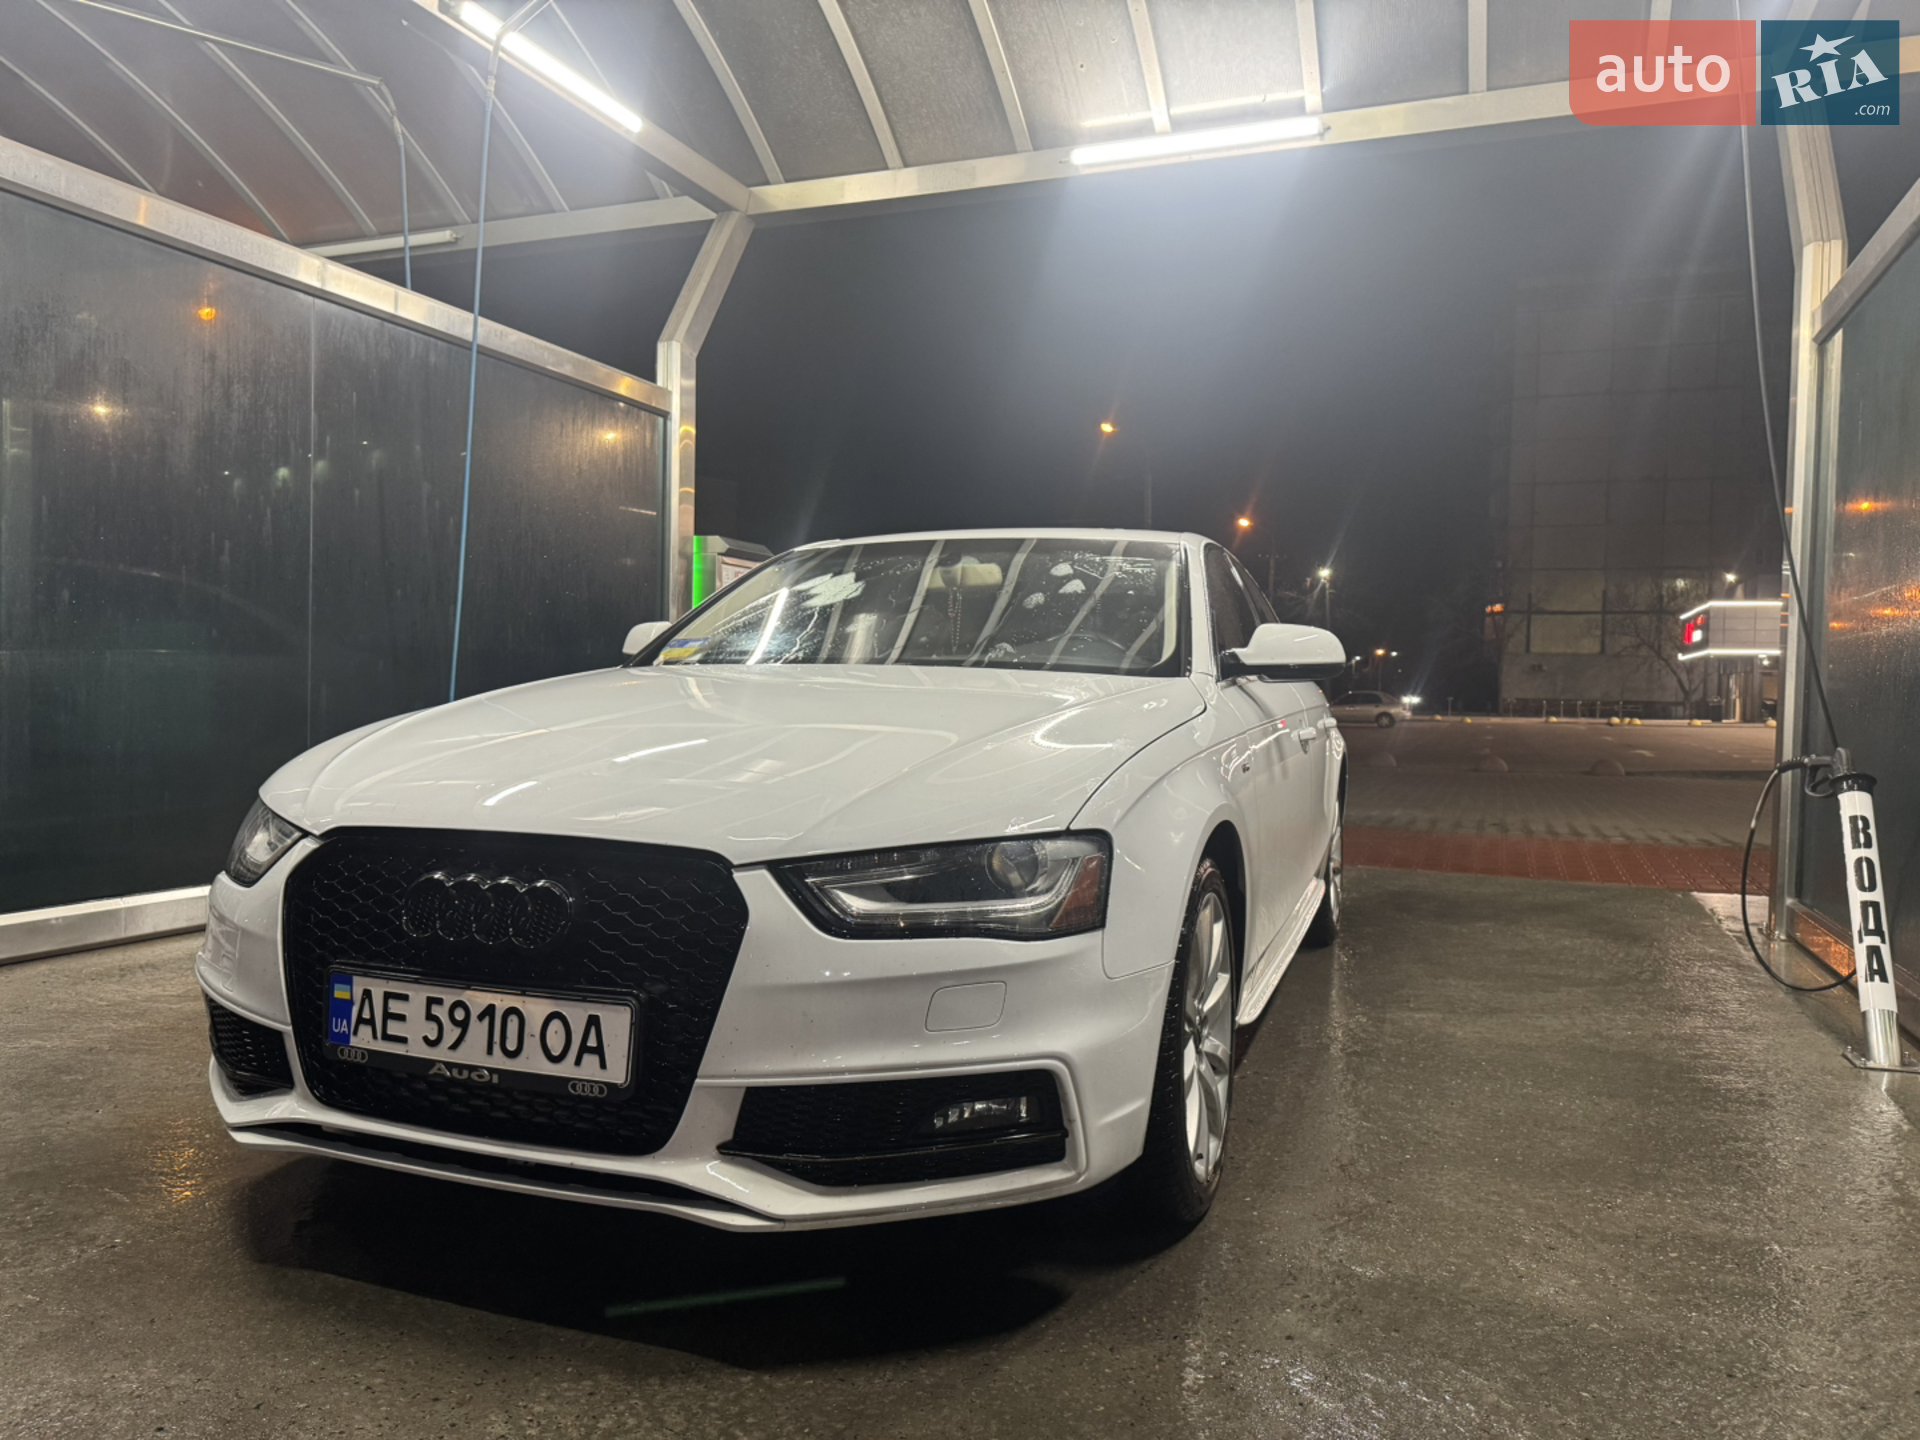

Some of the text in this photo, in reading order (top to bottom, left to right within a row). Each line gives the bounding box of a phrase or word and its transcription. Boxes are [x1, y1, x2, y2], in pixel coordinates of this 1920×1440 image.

[1848, 814, 1889, 984] ВОДА
[332, 1016, 349, 1035] UA
[352, 988, 608, 1070] AE 5910 OA
[428, 1062, 499, 1084] Audi
